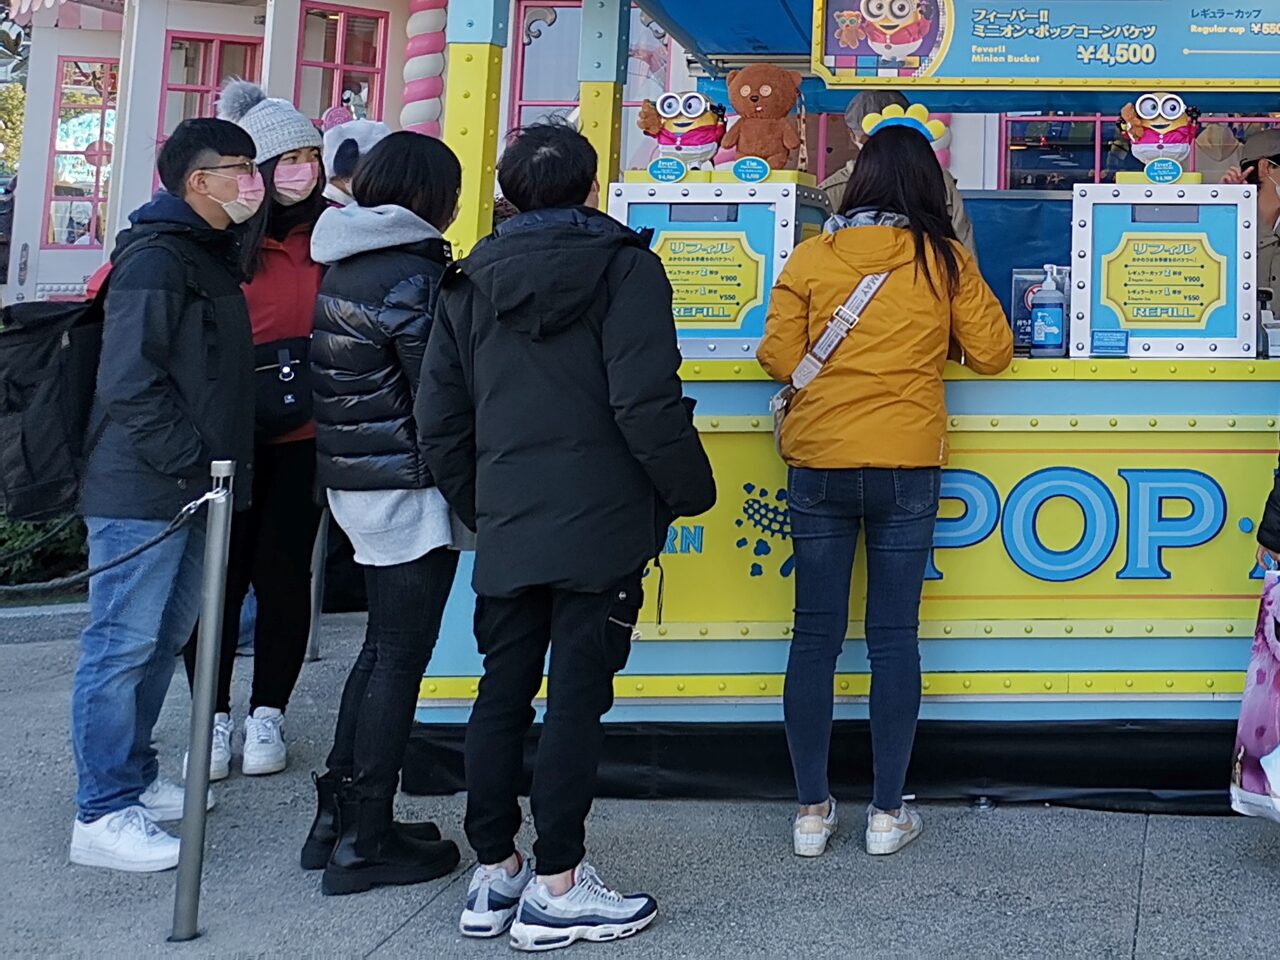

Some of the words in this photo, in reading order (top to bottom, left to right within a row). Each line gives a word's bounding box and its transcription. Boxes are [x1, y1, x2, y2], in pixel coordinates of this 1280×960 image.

[1190, 8, 1263, 19] レギュラーカップ
[1190, 24, 1227, 35] Regular
[1228, 26, 1246, 35] cup
[971, 54, 1005, 63] Minion
[1007, 54, 1041, 63] Bucket
[1076, 43, 1157, 67] ¥4,500
[670, 242, 735, 255] リフィル
[1133, 243, 1197, 255] リフィル
[861, 273, 882, 297] MAY
[1133, 307, 1195, 318] REFILL
[662, 525, 704, 554] RN
